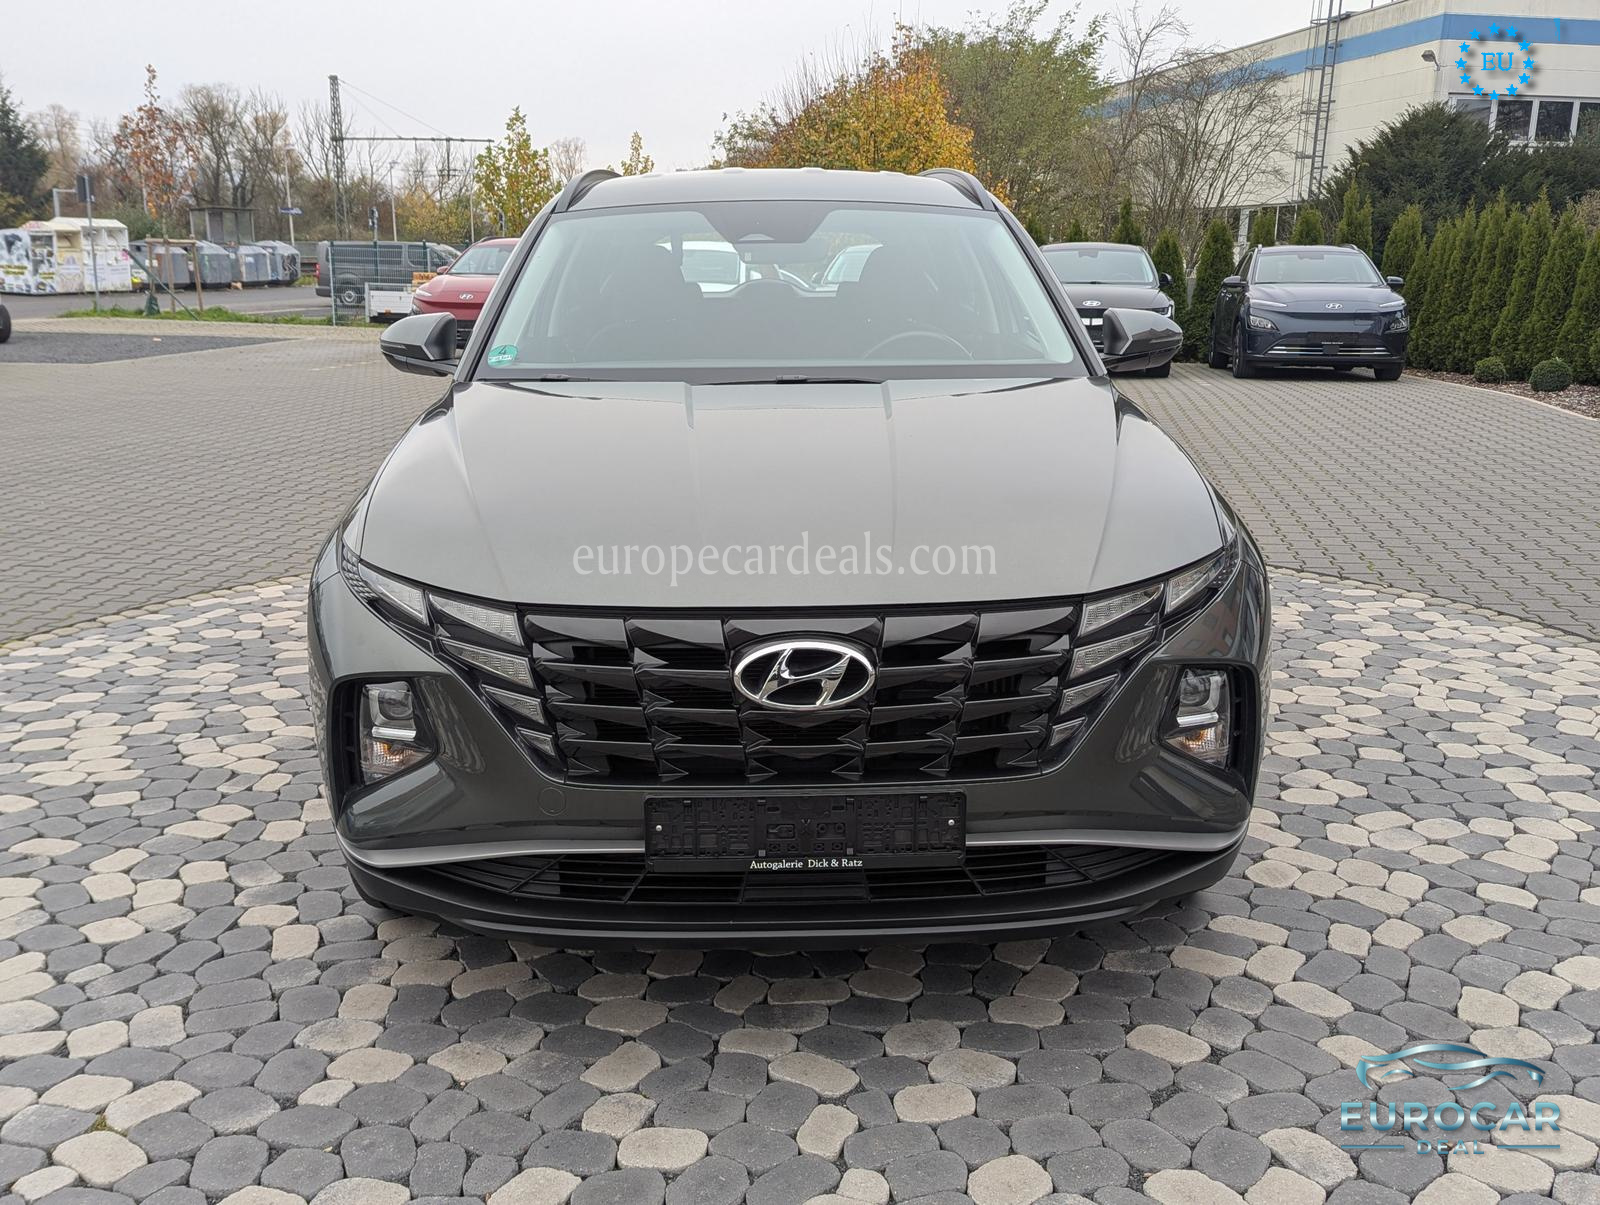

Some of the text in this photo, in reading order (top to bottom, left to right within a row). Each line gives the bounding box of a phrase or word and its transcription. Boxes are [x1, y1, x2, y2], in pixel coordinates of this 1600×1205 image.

[498, 345, 507, 355] 4
[750, 858, 863, 870] Autogalerie Dick & Ratz
